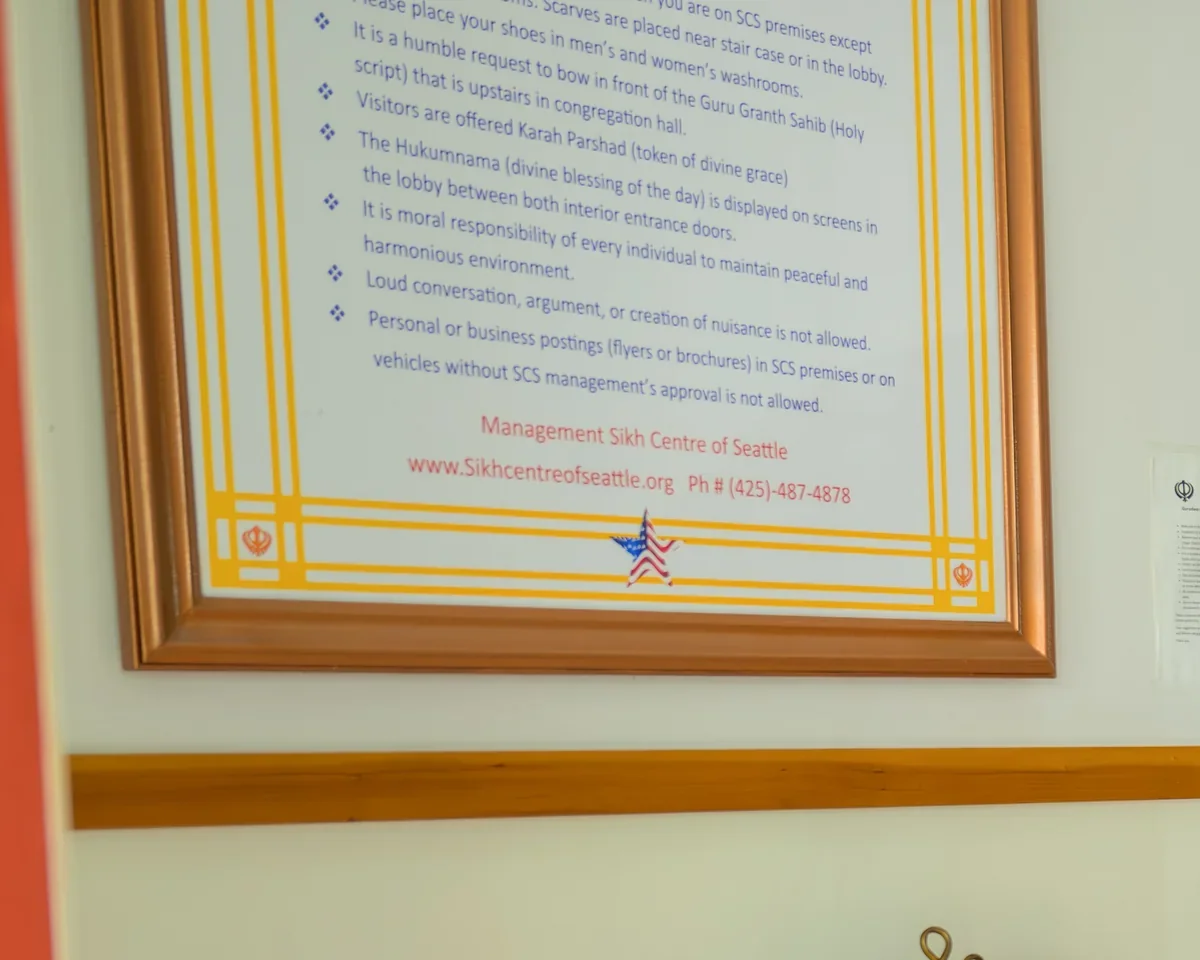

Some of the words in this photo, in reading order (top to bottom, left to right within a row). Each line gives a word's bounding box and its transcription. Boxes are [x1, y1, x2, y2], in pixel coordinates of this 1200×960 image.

[411, 0, 456, 25] place
[459, 13, 497, 33] your
[500, 19, 547, 44] shoes
[550, 29, 565, 48] in
[569, 37, 616, 59] men's
[619, 48, 647, 66] and
[651, 55, 717, 81] women's
[720, 70, 803, 99] washrooms.
[543, 0, 601, 23] Scarves
[604, 12, 629, 30] are
[632, 16, 681, 41] placed
[685, 31, 718, 49] near
[720, 37, 751, 56] stair
[754, 46, 785, 64] case
[787, 54, 804, 68] or
[806, 54, 820, 72] in
[822, 58, 845, 77] the
[848, 62, 888, 88] lobby.
[687, 1, 711, 18] are
[714, 7, 733, 22] on
[735, 9, 762, 29] SCS
[764, 19, 826, 44] premises
[829, 34, 873, 56] except
[353, 20, 366, 41] It
[370, 24, 384, 44] is
[388, 32, 398, 47] a
[403, 30, 467, 61] humble
[471, 49, 532, 75] request
[535, 60, 553, 79] to
[556, 63, 590, 86] bow
[594, 71, 609, 90] in
[612, 74, 649, 99] front
[652, 85, 668, 102] of
[671, 88, 696, 108] the
[699, 94, 735, 116] Guru
[738, 102, 787, 126] Granth
[789, 112, 827, 134] Sahib
[830, 119, 865, 145] (Holy
[354, 59, 408, 86] script)
[412, 67, 448, 90] that
[451, 74, 465, 93] is
[468, 81, 532, 106] upstairs
[535, 91, 550, 109] in
[554, 99, 653, 129] congregation
[656, 113, 687, 136] hall.
[356, 89, 420, 119] Visitors
[424, 107, 451, 125] are
[455, 110, 514, 136] offered
[518, 121, 563, 145] Karah
[567, 130, 627, 157] Parshad
[631, 141, 678, 166] (token
[681, 152, 697, 169] of
[699, 155, 743, 178] divine
[745, 167, 788, 189] grace)
[357, 130, 391, 153] The
[395, 136, 501, 172] Hukumnama
[505, 156, 559, 182] (divine
[562, 165, 624, 197] blessing
[627, 179, 643, 195] of
[646, 181, 671, 201] the
[675, 186, 706, 210] day)
[709, 192, 721, 209] is
[723, 194, 789, 221] displayed
[791, 210, 810, 224] on
[812, 213, 863, 233] screens
[865, 218, 878, 235] in
[362, 165, 392, 186] the
[396, 169, 443, 198] lobby
[447, 177, 518, 206] between
[522, 190, 560, 213] both
[563, 198, 621, 222] interior
[623, 212, 689, 234] entrance
[692, 219, 737, 242] doors.
[363, 199, 375, 219] It
[379, 202, 393, 221] is
[397, 209, 446, 229] moral
[450, 217, 557, 249] responsibility
[560, 231, 577, 249] of
[580, 237, 623, 259] every
[626, 240, 697, 266] individual
[700, 253, 716, 270] to
[719, 258, 780, 279] maintain
[783, 268, 841, 288] peaceful
[843, 275, 868, 292] and
[363, 233, 465, 266] harmonious
[468, 254, 575, 281] environment.
[366, 269, 408, 292] Loud
[412, 280, 522, 309] conversation,
[525, 295, 606, 320] argument,
[609, 306, 626, 320] or
[629, 308, 690, 328] creation
[692, 314, 708, 331] of
[711, 318, 773, 339] nuisance
[776, 324, 787, 341] is
[790, 329, 813, 345] not
[815, 329, 872, 351] allowed.
[368, 309, 441, 335] Personal
[444, 323, 463, 337] or
[466, 320, 537, 346] business
[539, 334, 604, 357] postings
[607, 338, 654, 360] (flyers
[656, 348, 673, 361] or
[676, 346, 752, 374] brochures)
[755, 356, 768, 373] in
[771, 358, 796, 376] SCS
[799, 365, 859, 384] premises
[861, 372, 876, 385] or
[878, 374, 896, 388] on
[373, 350, 441, 374] vehicles
[444, 358, 509, 381] without
[512, 365, 542, 384] SCS
[545, 372, 657, 396] management's
[660, 384, 722, 403] approval
[725, 388, 737, 405] is
[740, 392, 764, 408] not
[767, 392, 824, 413] allowed.
[481, 415, 605, 444] Management
[609, 427, 645, 447] Sikh
[650, 430, 707, 453] Centre
[711, 436, 729, 455] of
[732, 438, 788, 461] Seattle
[407, 457, 675, 496] www.Sikhcentreofseattle.org
[688, 474, 710, 494] Ph
[714, 477, 724, 495] #
[728, 476, 851, 505] (425)-487-4878
